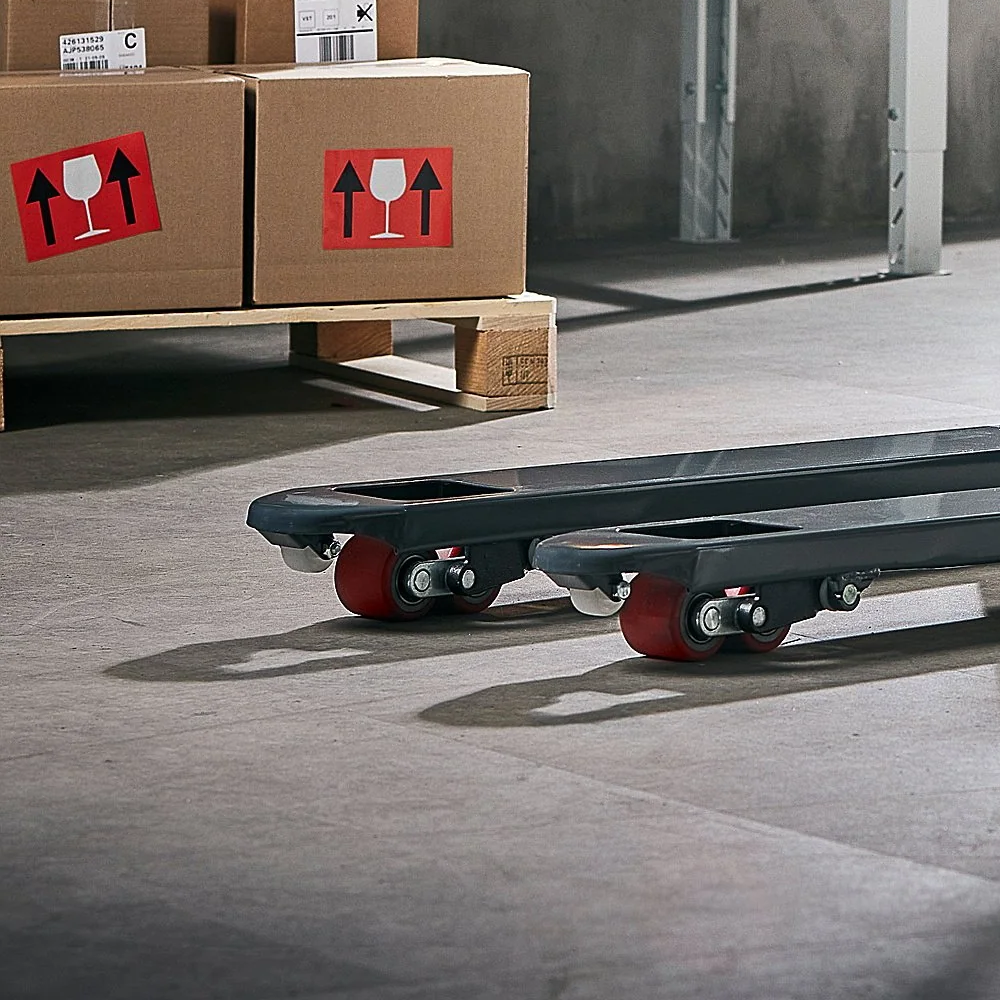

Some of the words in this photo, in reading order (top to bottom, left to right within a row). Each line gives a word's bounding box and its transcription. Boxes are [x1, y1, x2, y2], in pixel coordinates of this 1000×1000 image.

[62, 36, 104, 46] 426131529
[124, 32, 137, 49] C
[63, 45, 104, 54] AJP538065
